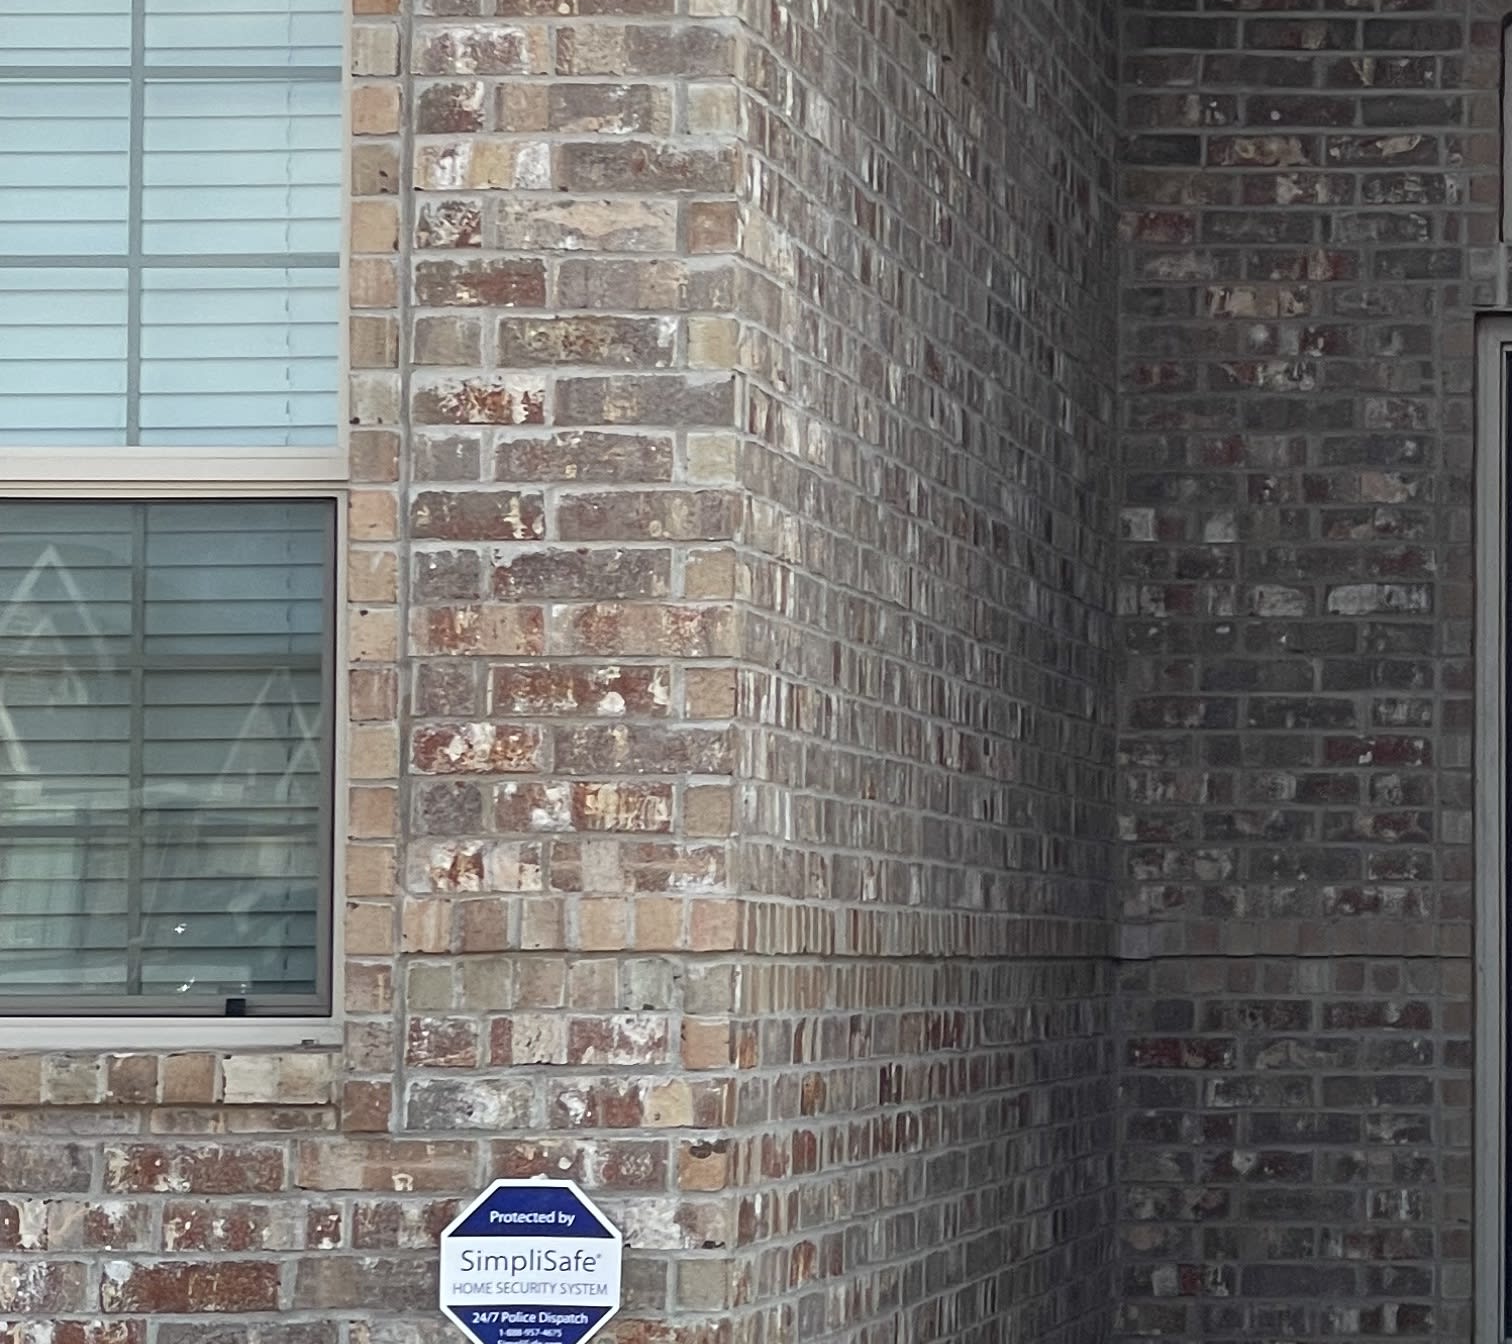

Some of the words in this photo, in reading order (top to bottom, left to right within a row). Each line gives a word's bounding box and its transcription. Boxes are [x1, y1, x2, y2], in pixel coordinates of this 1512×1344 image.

[490, 1210, 555, 1224] Protected
[558, 1211, 575, 1226] by
[460, 1249, 598, 1276] SimpliSafe
[452, 1281, 493, 1295] HOME
[496, 1281, 558, 1295] SECURITY
[560, 1282, 608, 1296] SYSTEM
[472, 1311, 498, 1324] 24/7
[501, 1311, 536, 1324] Police
[539, 1311, 589, 1325] Dispatch
